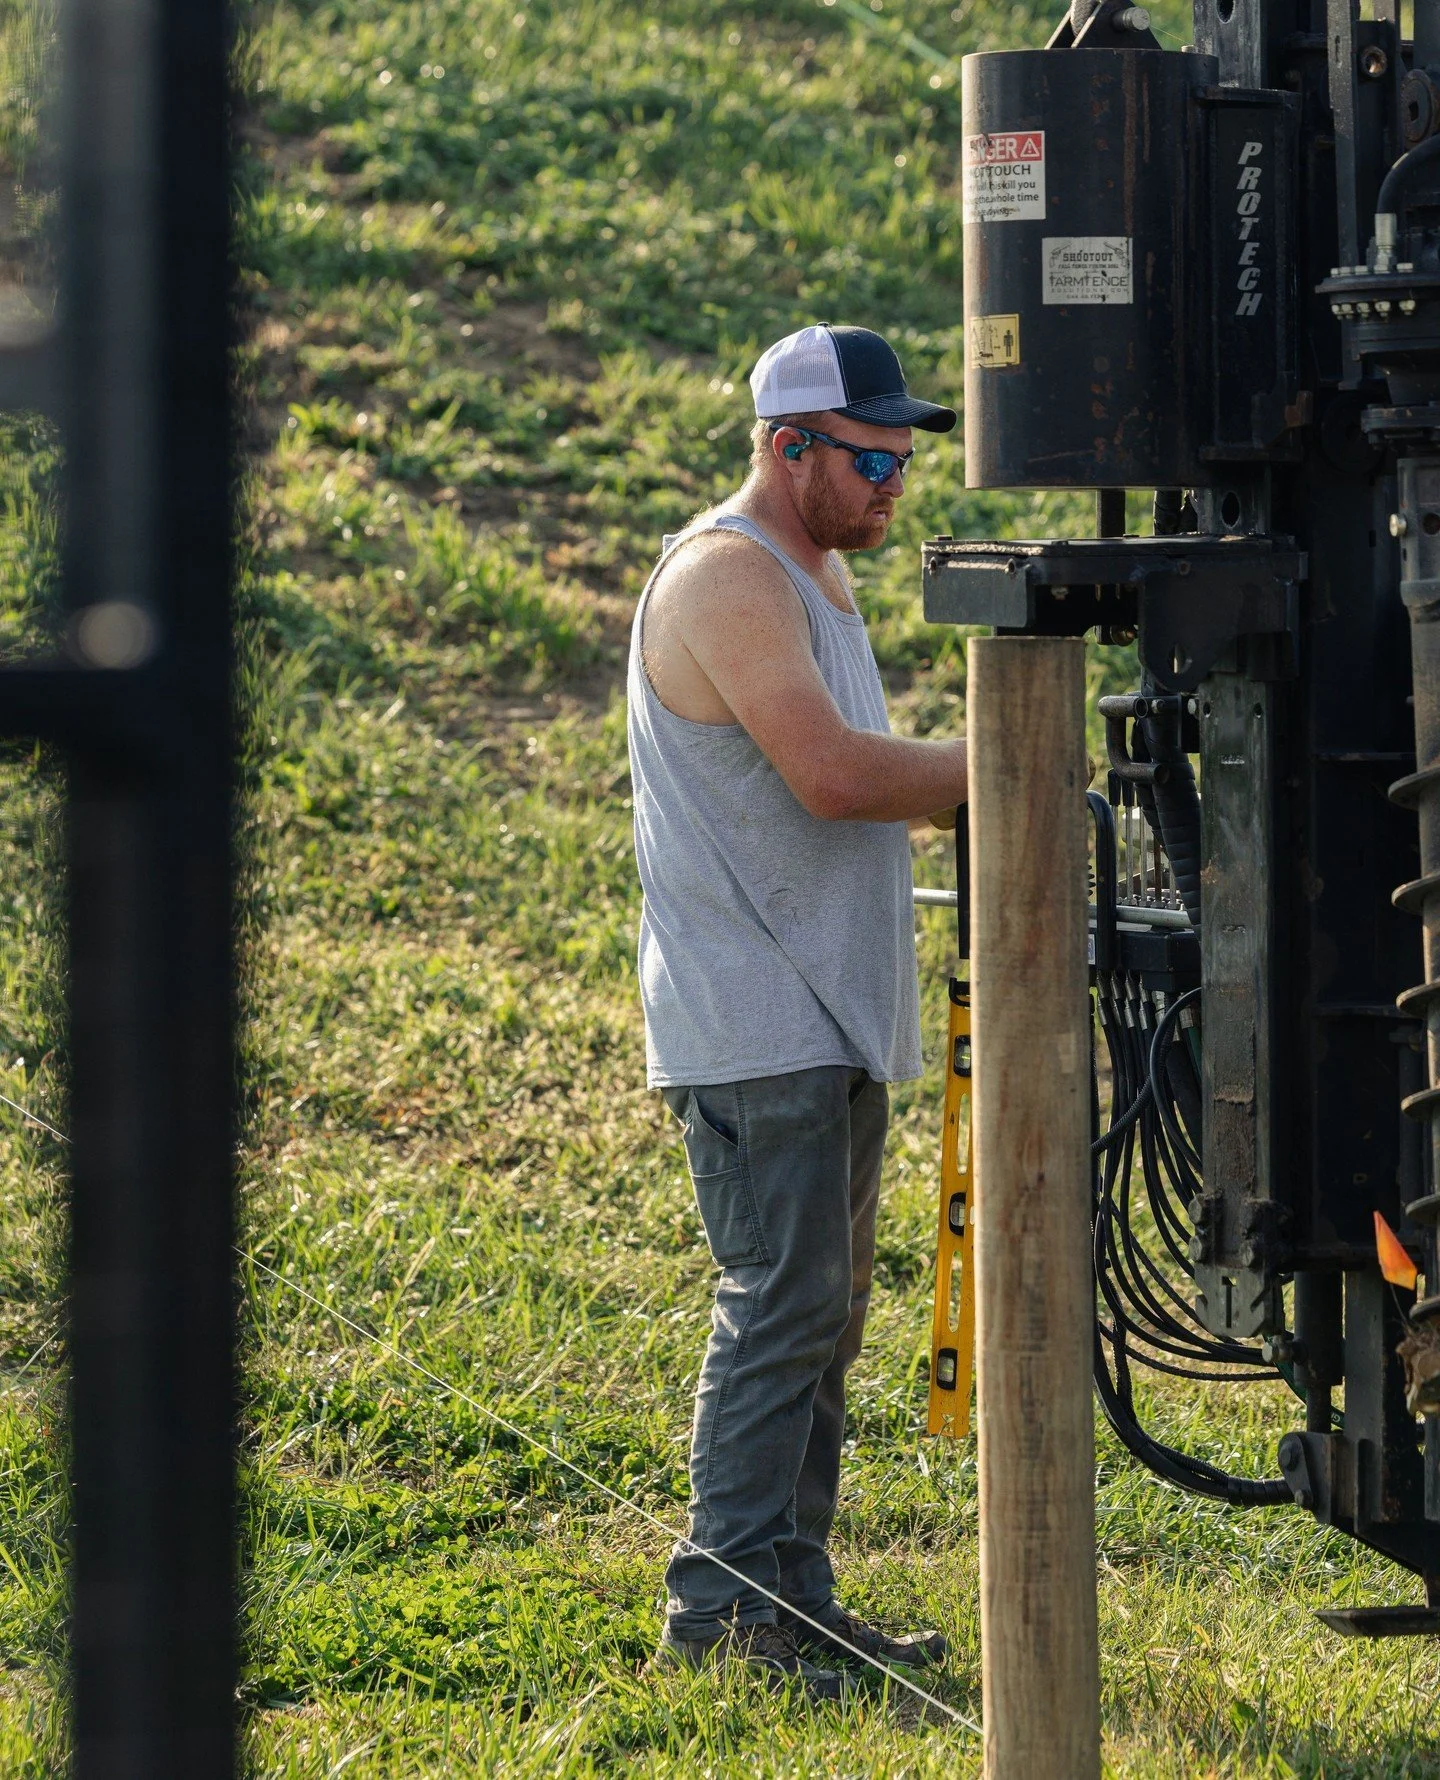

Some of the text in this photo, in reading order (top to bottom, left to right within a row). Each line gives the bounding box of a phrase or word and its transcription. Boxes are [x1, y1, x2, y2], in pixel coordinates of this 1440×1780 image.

[970, 138, 1018, 161] NGER
[987, 164, 1031, 177] TOUCH
[1017, 181, 1036, 191] you
[1017, 192, 1039, 202] time
[1235, 141, 1263, 316] PROTECH
